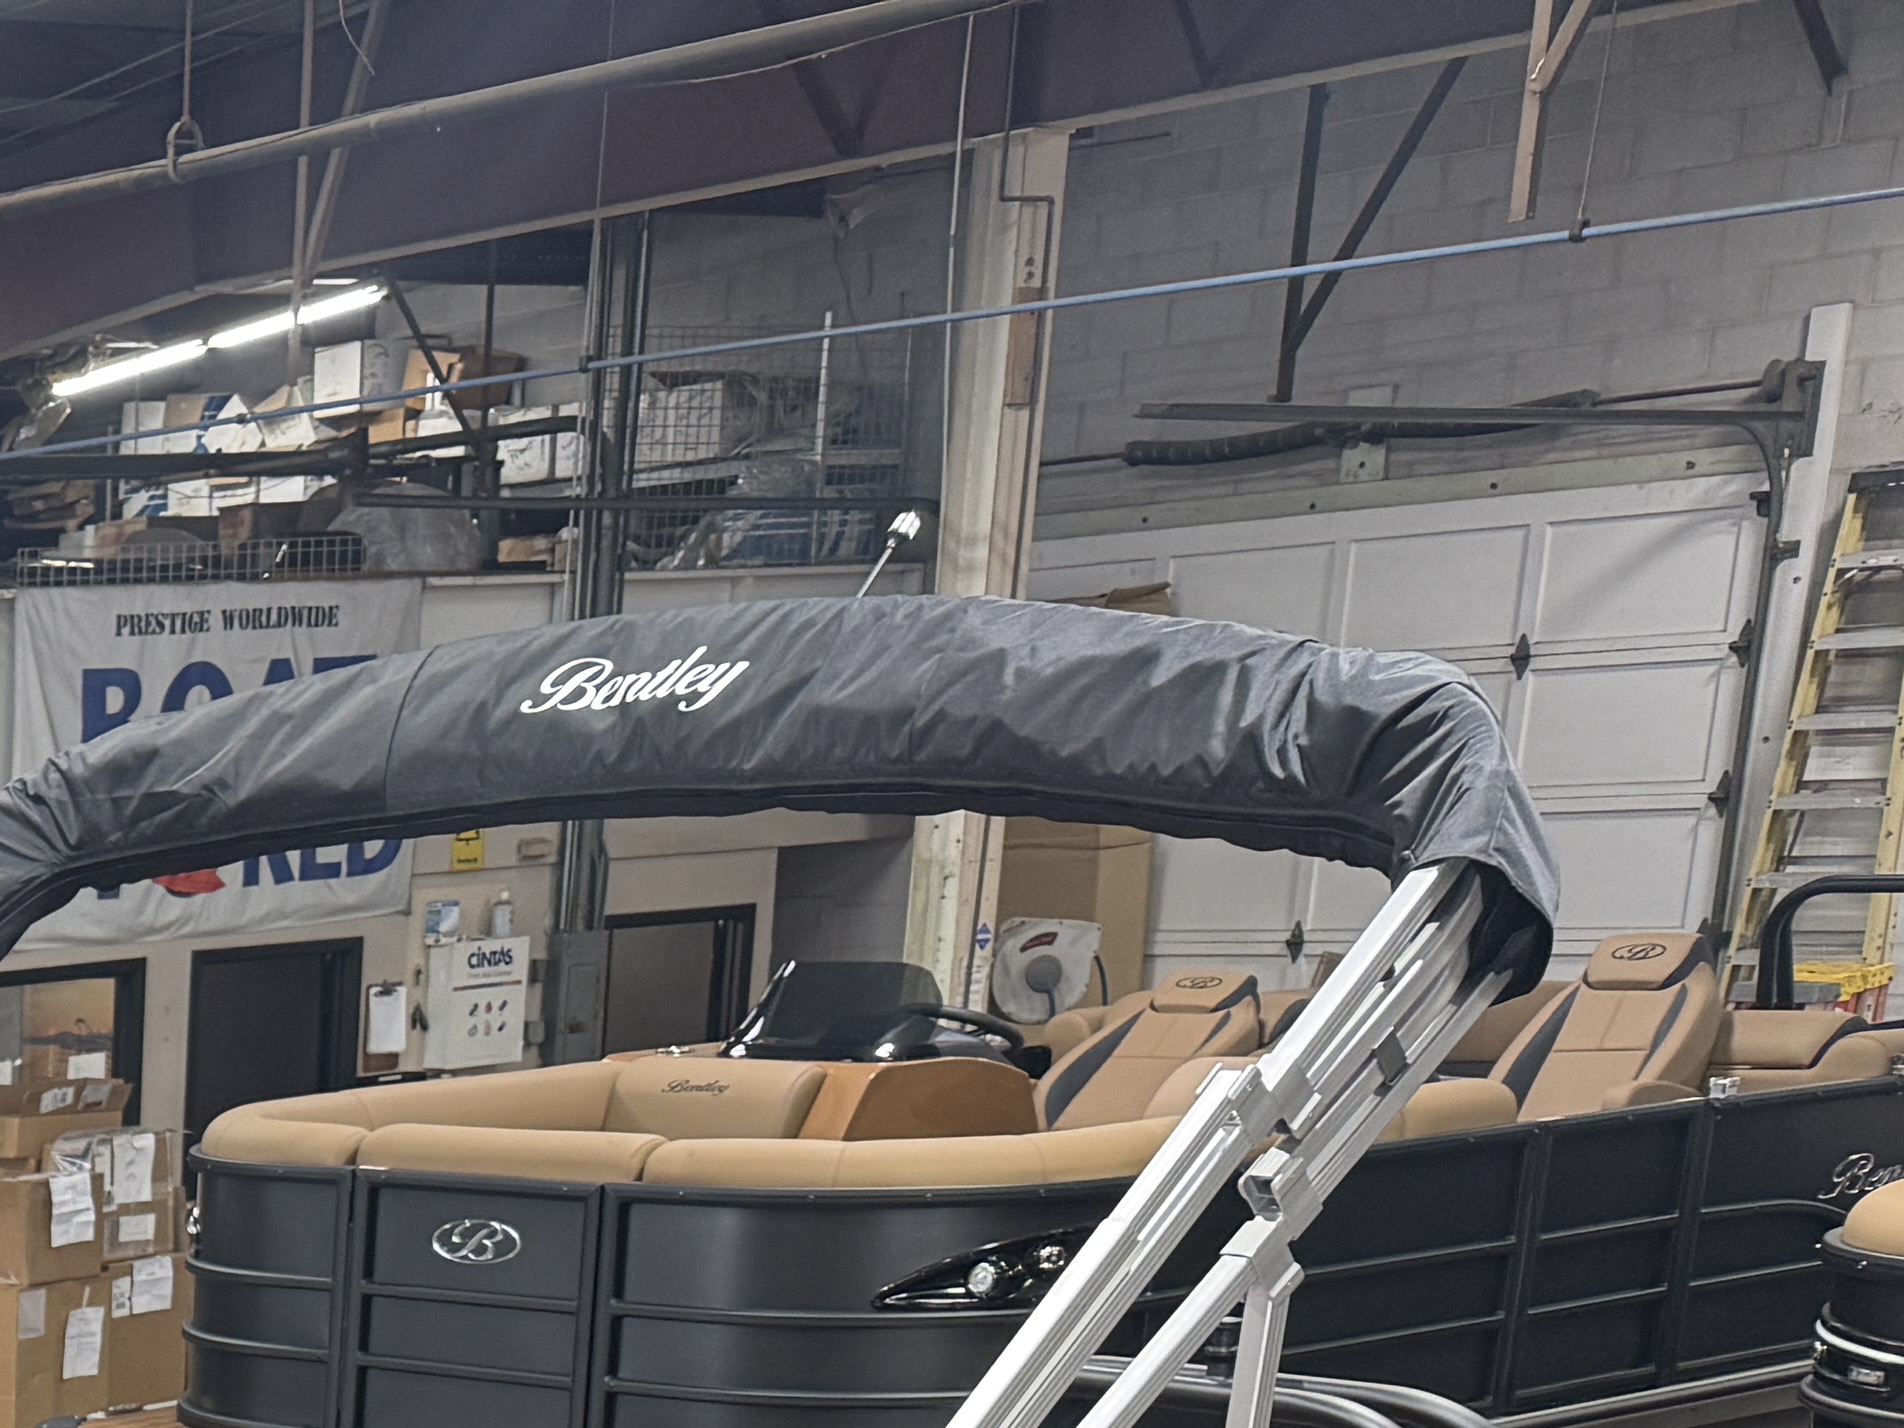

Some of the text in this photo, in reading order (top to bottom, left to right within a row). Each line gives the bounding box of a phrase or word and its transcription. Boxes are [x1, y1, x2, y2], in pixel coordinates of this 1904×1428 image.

[114, 604, 340, 637] PRESTIGE WORLDWIDE
[520, 645, 750, 713] Bentley
[468, 945, 513, 969] CINTAS
[661, 1079, 730, 1096] Bentley
